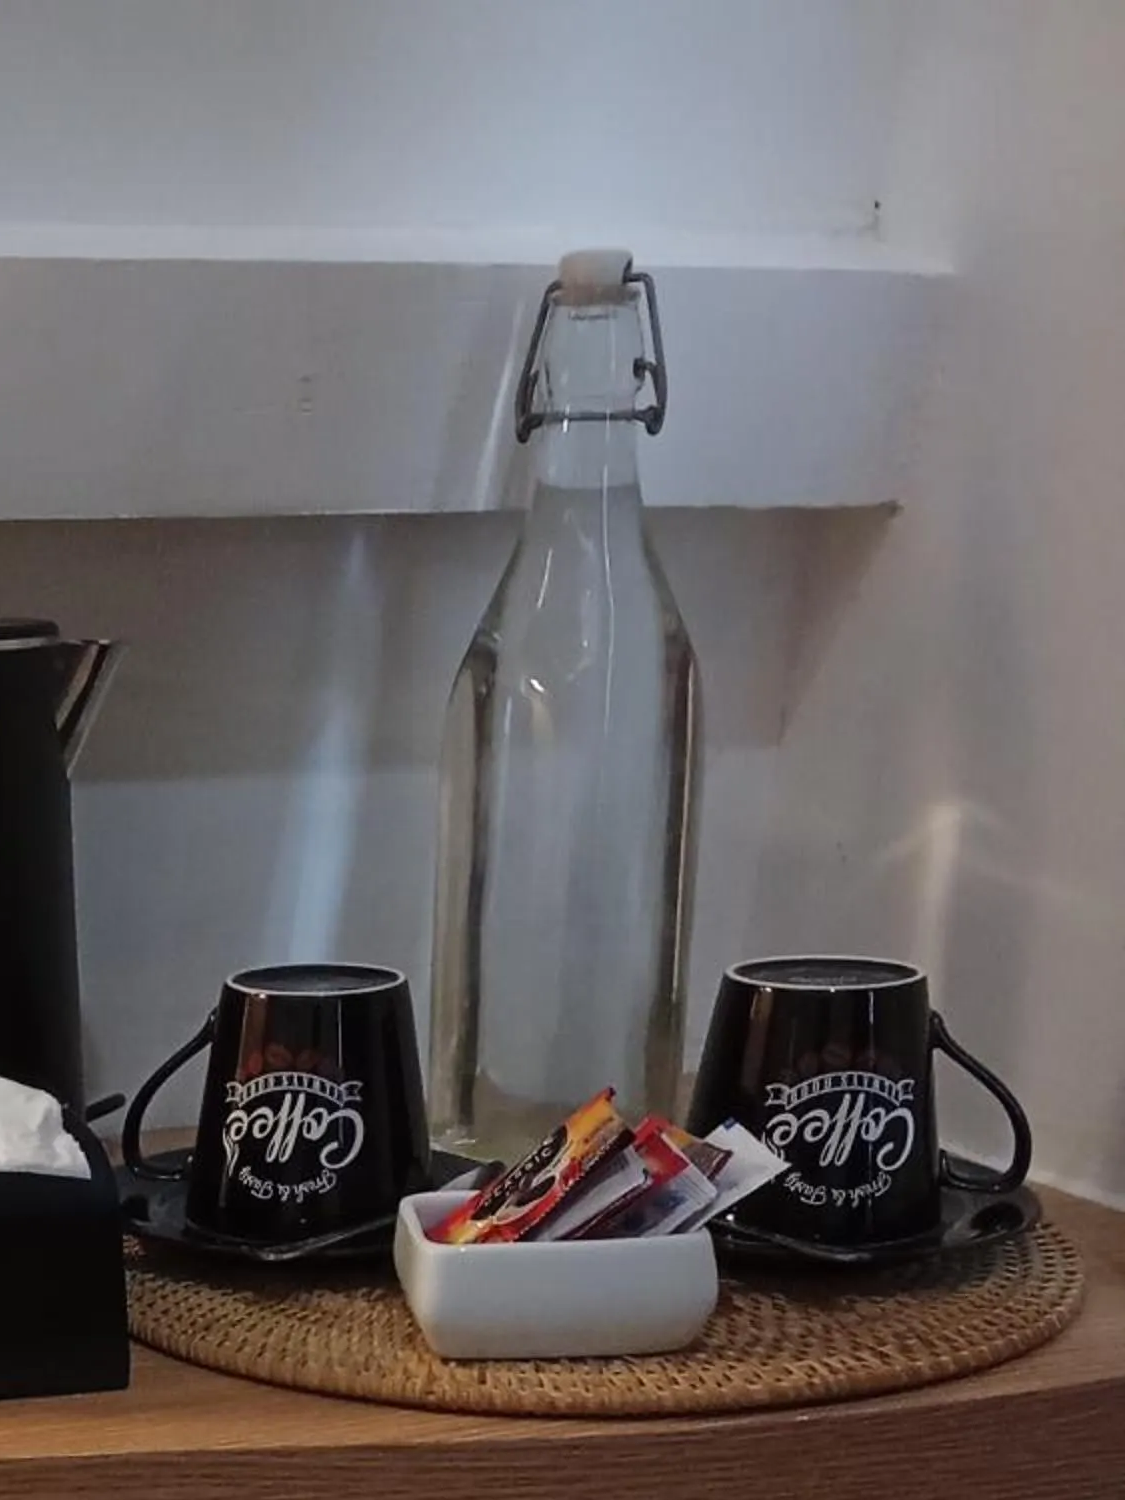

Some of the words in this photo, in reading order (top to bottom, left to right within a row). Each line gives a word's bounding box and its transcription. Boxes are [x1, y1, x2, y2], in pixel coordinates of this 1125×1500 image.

[225, 1091, 364, 1170] Coffee
[765, 1092, 915, 1172] Coffee
[277, 1182, 291, 1202] &
[294, 1168, 338, 1204] Fresh
[782, 1172, 827, 1206] Tasty
[831, 1188, 846, 1207] &
[847, 1171, 893, 1209] Fresh
